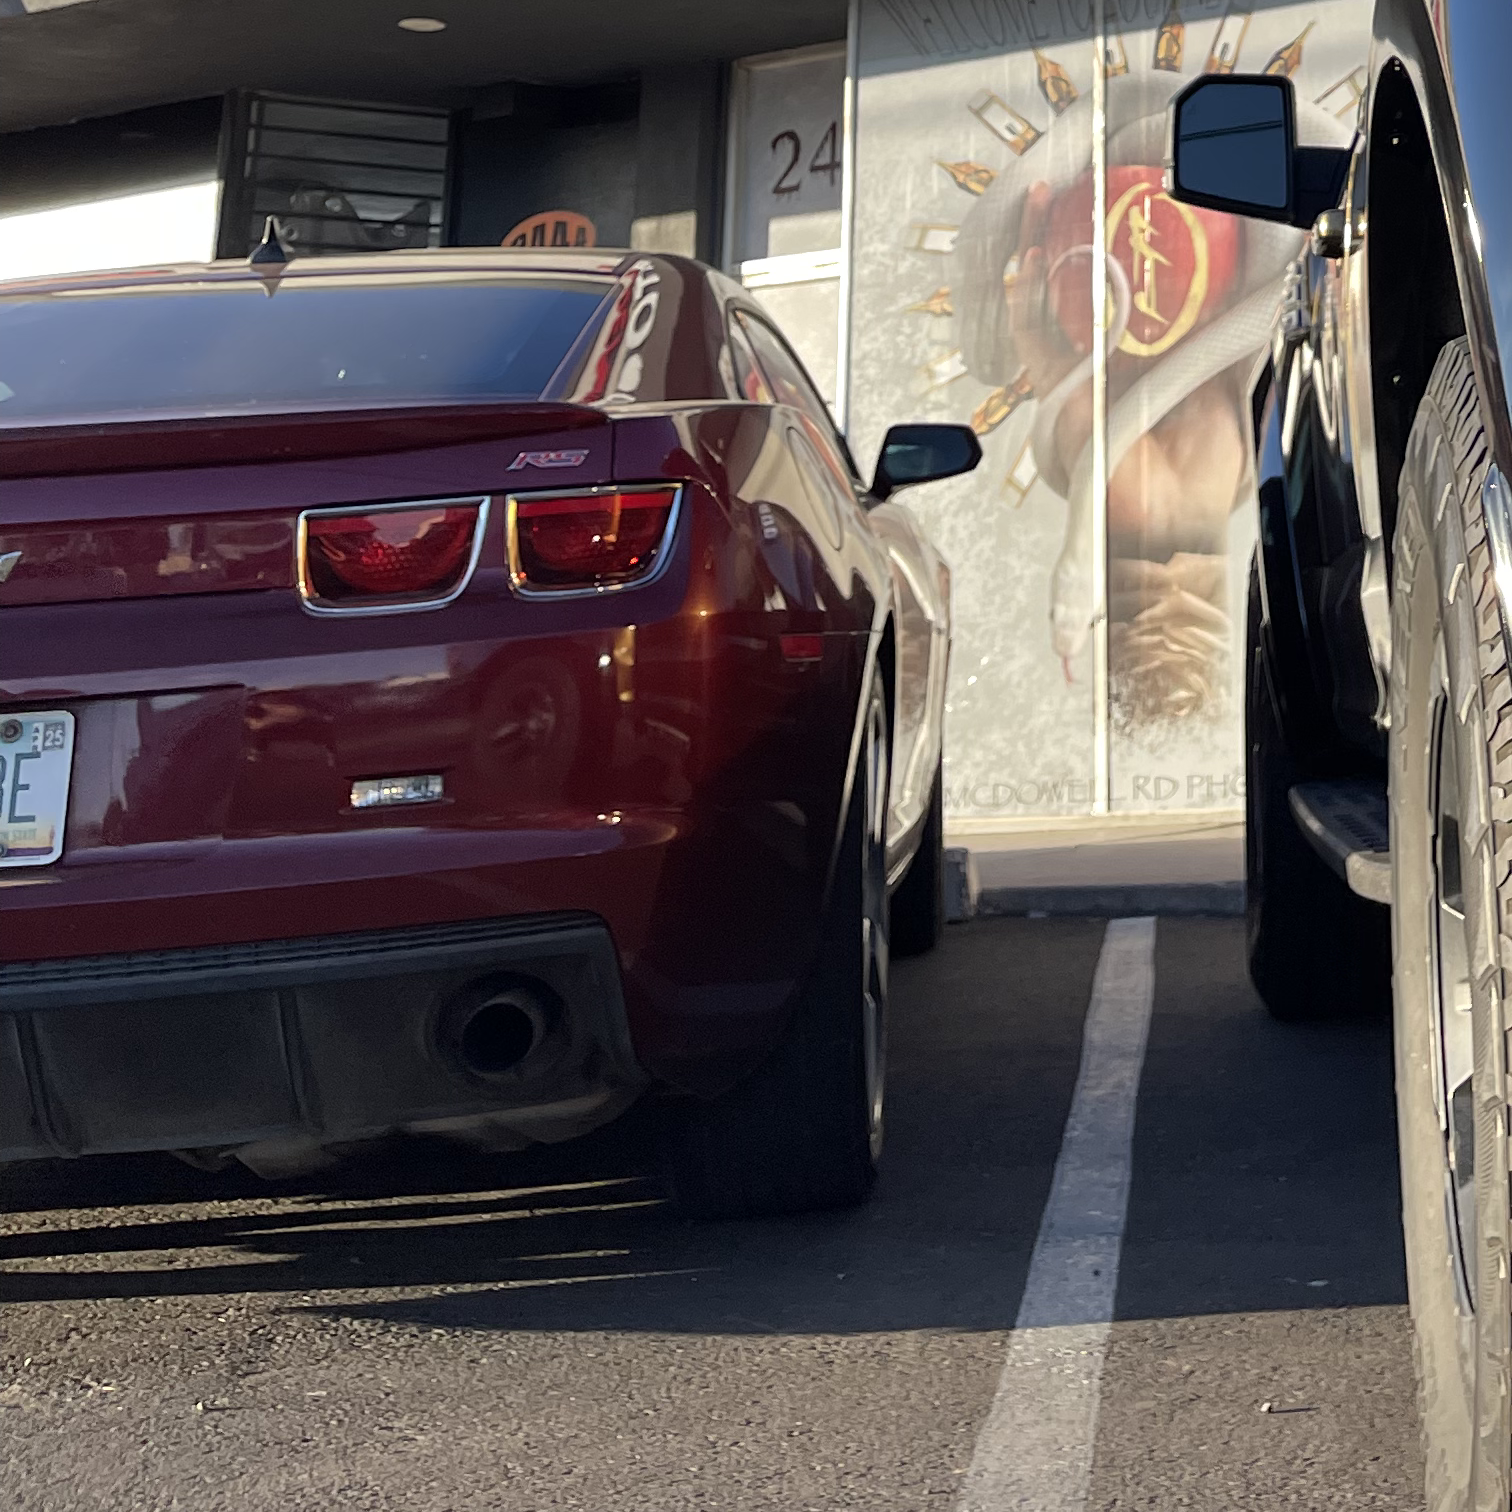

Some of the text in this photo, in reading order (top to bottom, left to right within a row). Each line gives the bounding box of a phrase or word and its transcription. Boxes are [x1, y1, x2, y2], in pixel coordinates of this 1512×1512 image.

[772, 121, 840, 194] 24
[505, 449, 589, 472] RS
[44, 730, 64, 746] 25
[0, 752, 41, 823] E
[1132, 774, 1180, 801] RD
